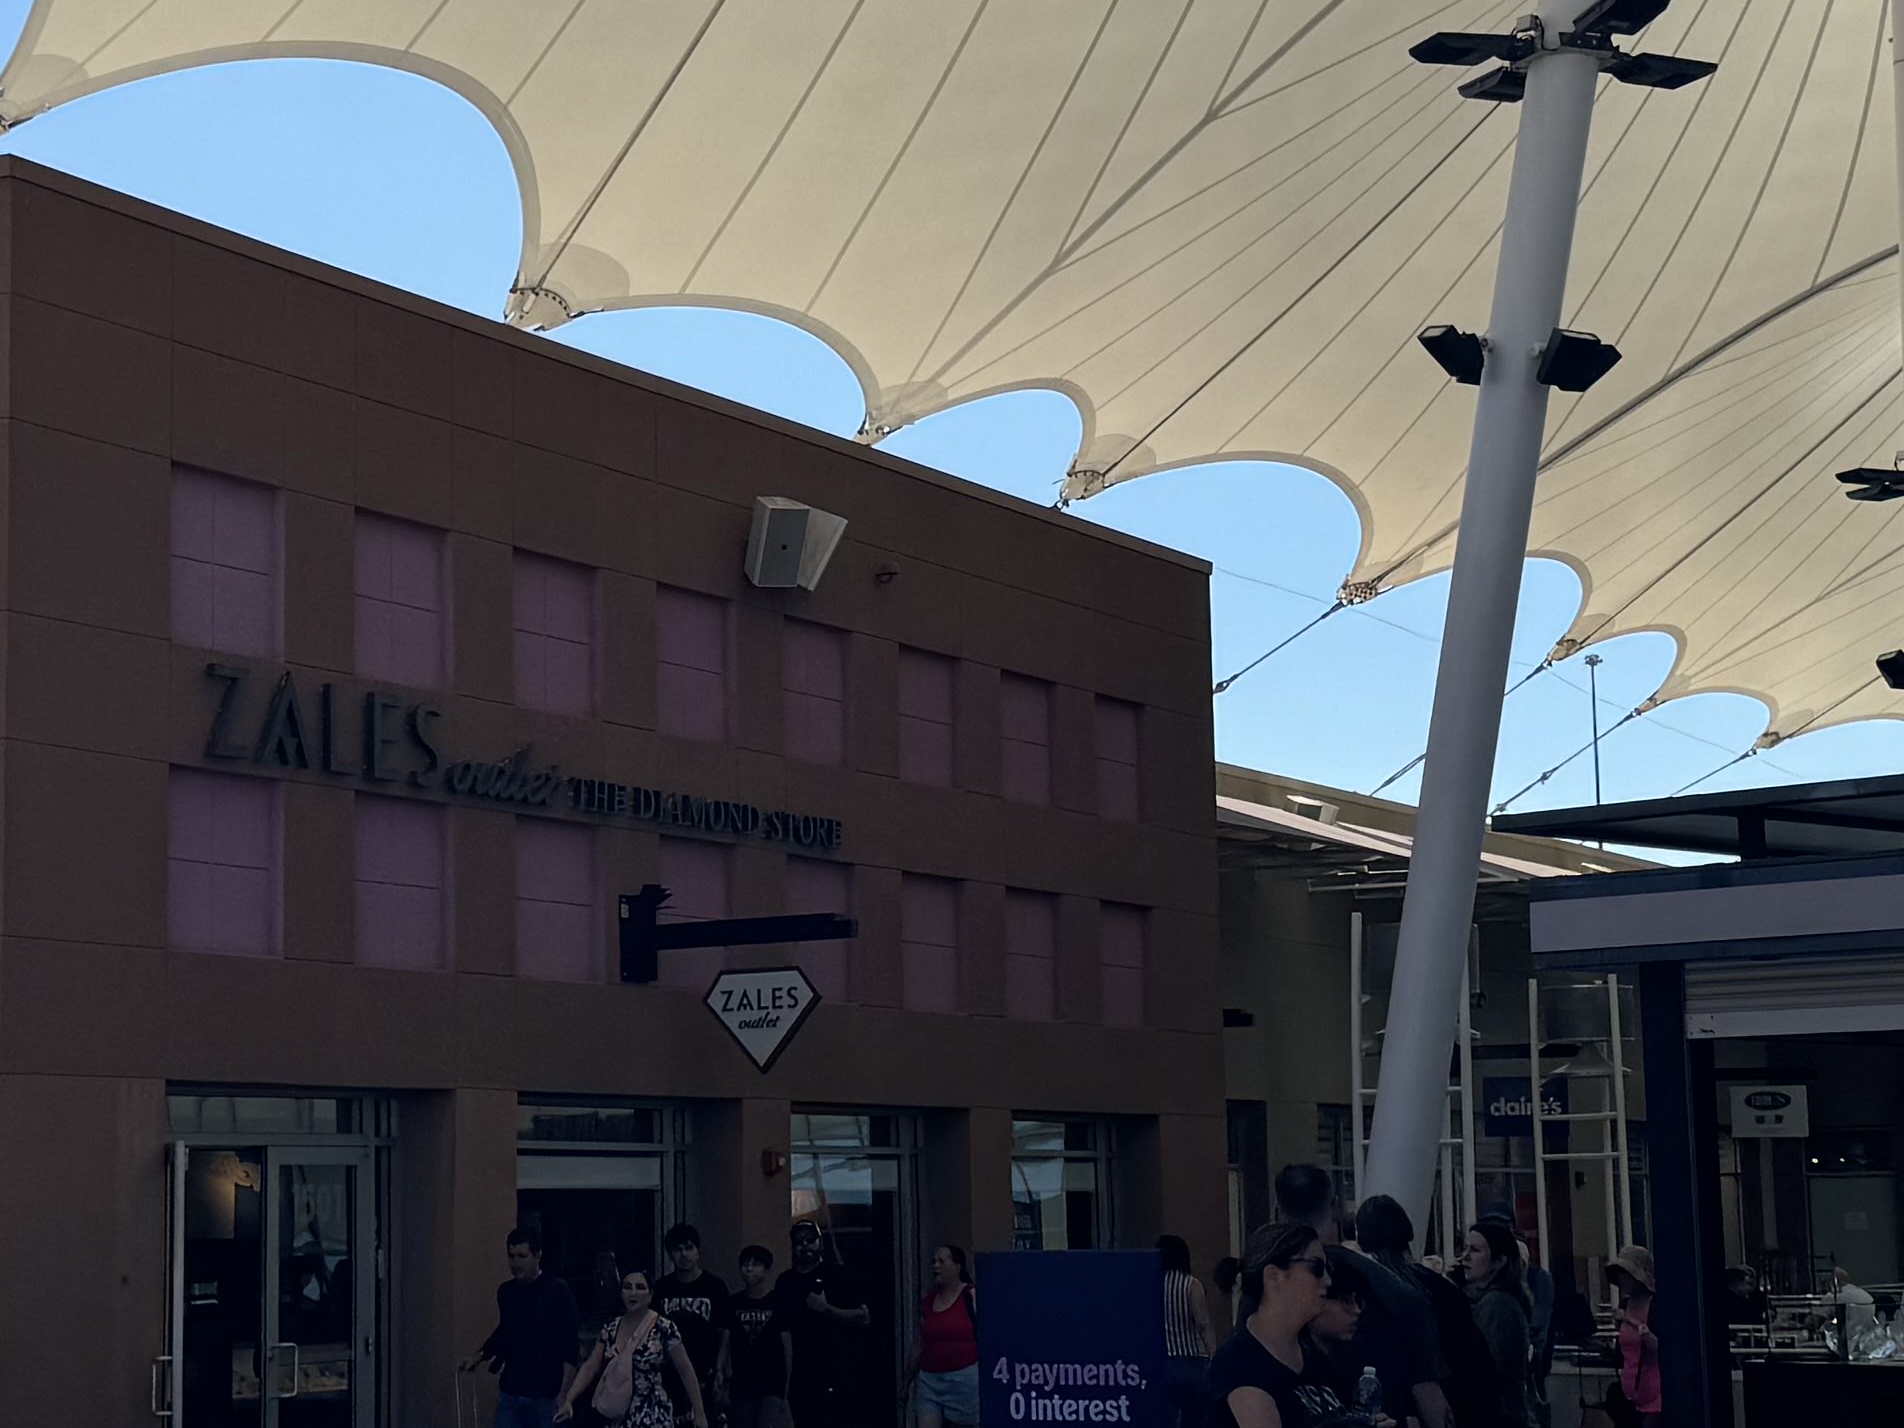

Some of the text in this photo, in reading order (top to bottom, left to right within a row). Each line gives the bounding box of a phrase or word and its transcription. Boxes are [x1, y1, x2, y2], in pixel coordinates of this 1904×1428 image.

[205, 662, 843, 847] ZALES outlet THE DIAMOND STORE
[720, 986, 799, 1012] ZALES
[738, 1011, 780, 1029] outlet
[992, 1356, 1147, 1392] 4 payments,
[1010, 1390, 1131, 1422] 0 interest
